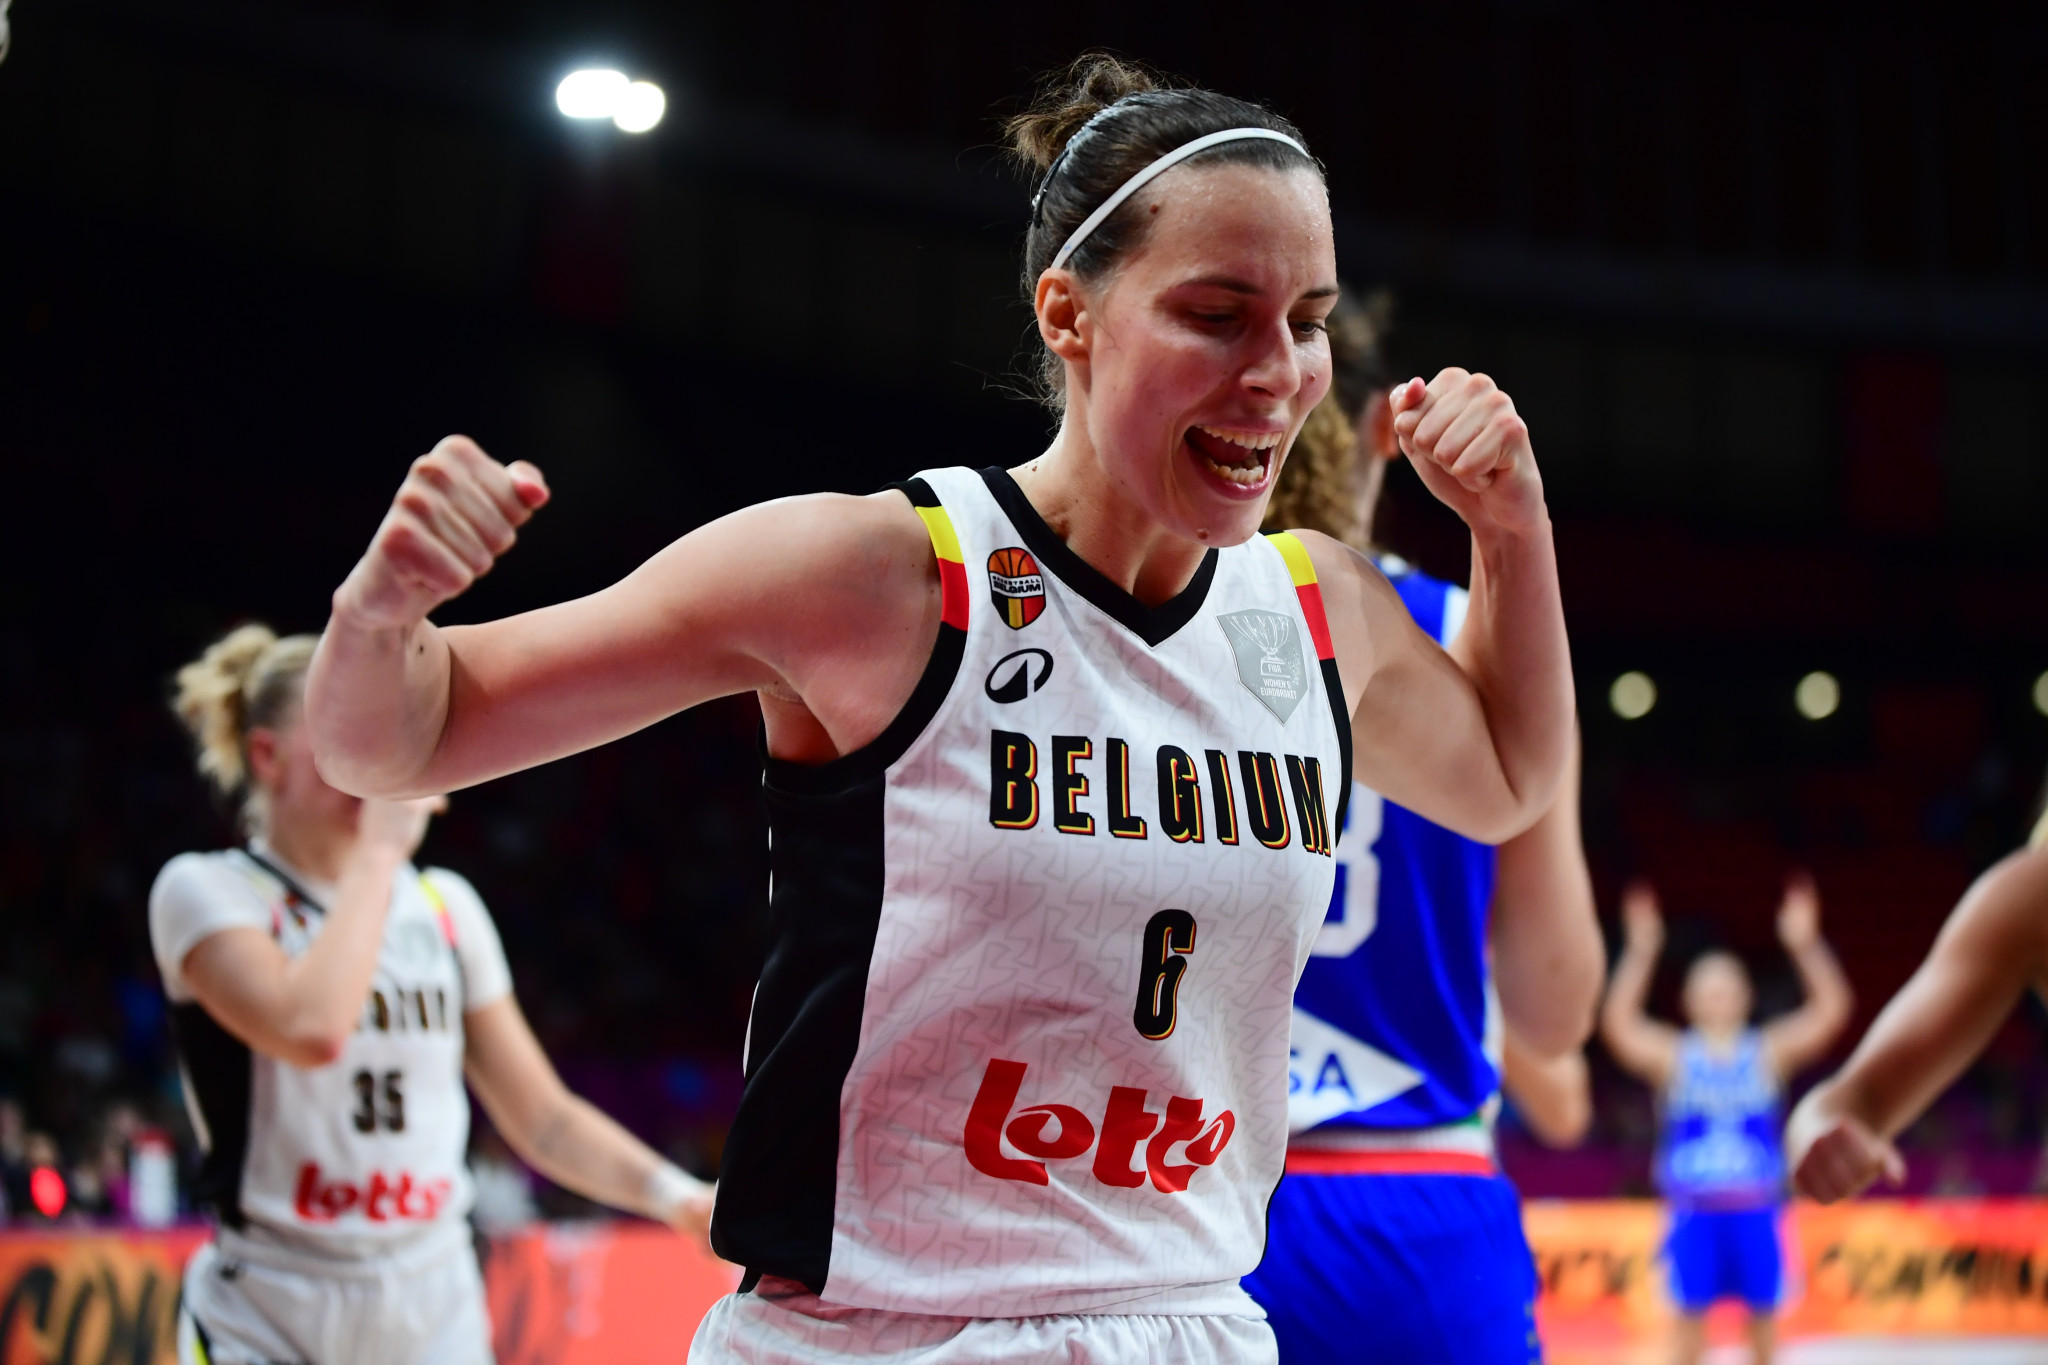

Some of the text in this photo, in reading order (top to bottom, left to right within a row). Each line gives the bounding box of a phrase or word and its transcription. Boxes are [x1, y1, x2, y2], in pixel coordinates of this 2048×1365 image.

[993, 581, 1041, 594] BELGIUM
[1260, 687, 1297, 700] EUROBASKET
[989, 728, 1332, 858] BELGIUM
[1133, 908, 1197, 1041] 6
[353, 1068, 406, 1134] 35
